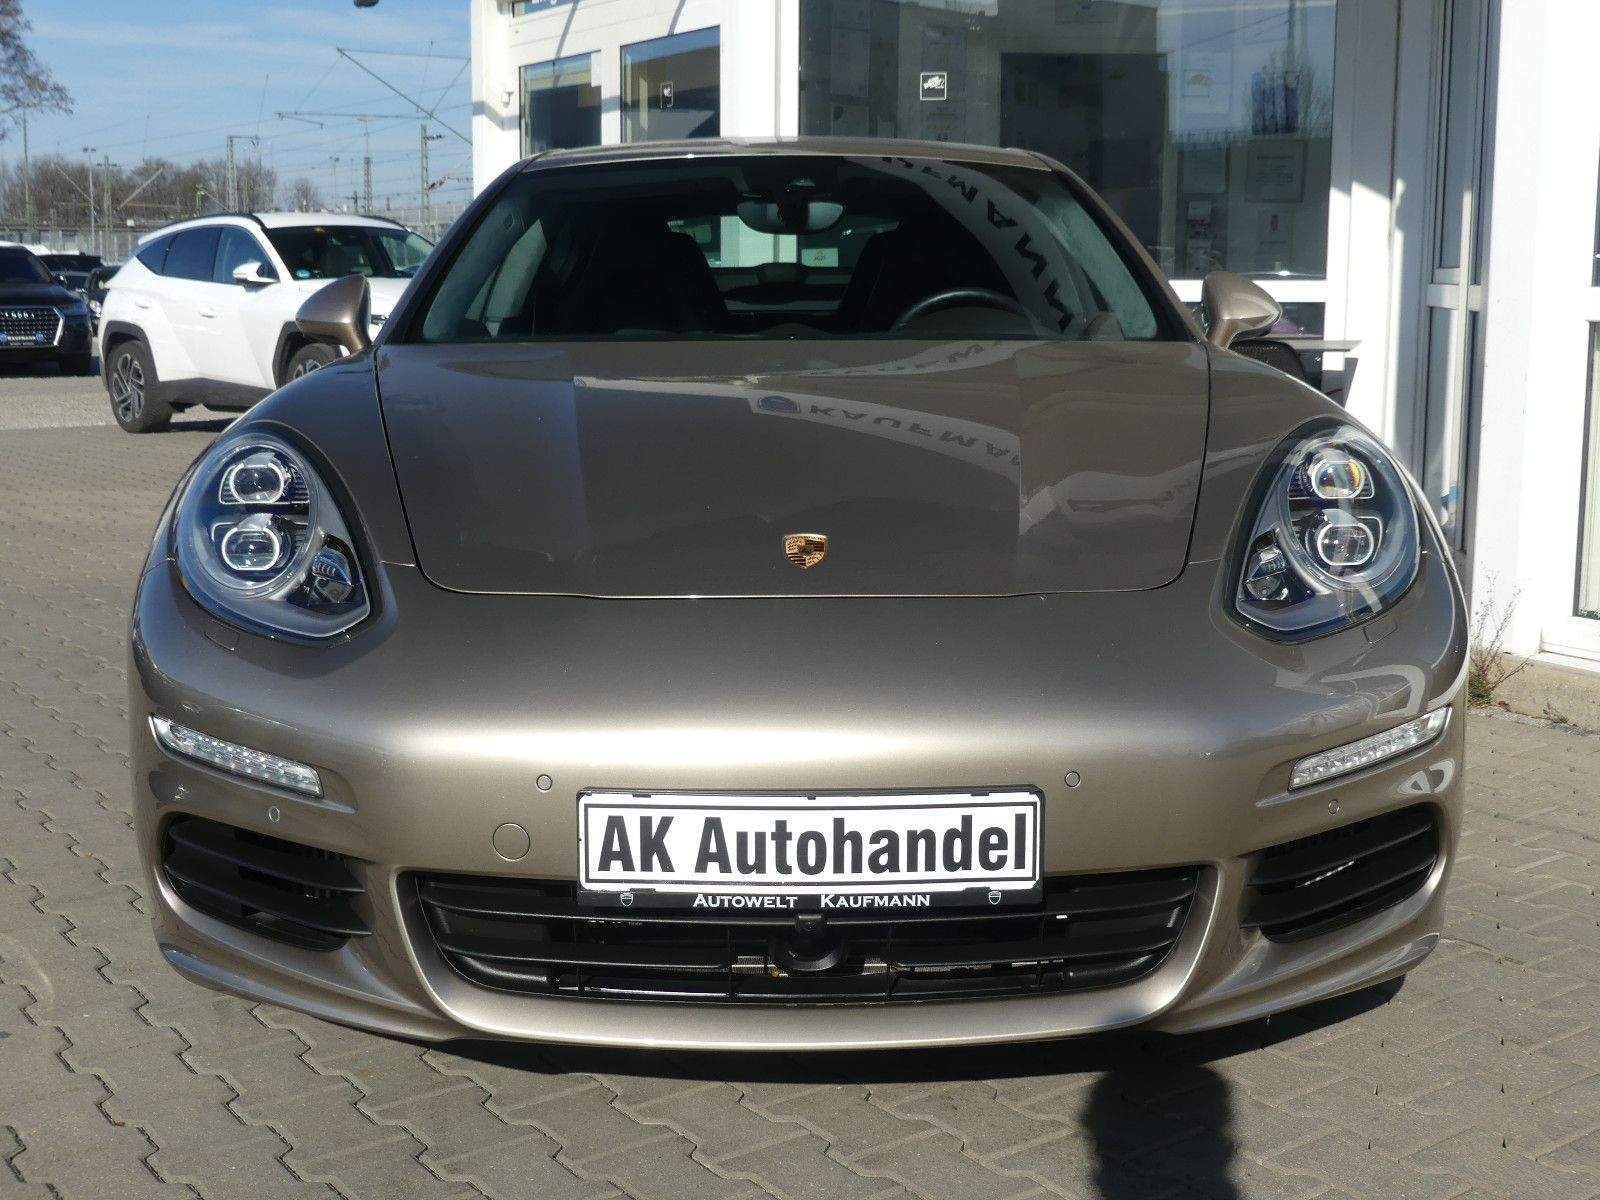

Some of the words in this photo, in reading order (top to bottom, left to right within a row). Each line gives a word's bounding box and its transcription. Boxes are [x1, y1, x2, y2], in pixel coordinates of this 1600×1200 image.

[597, 814, 676, 873] AK
[694, 812, 1027, 876] Autohandel
[692, 892, 798, 909] AUTOWELT
[820, 892, 931, 909] KAUFMANN
